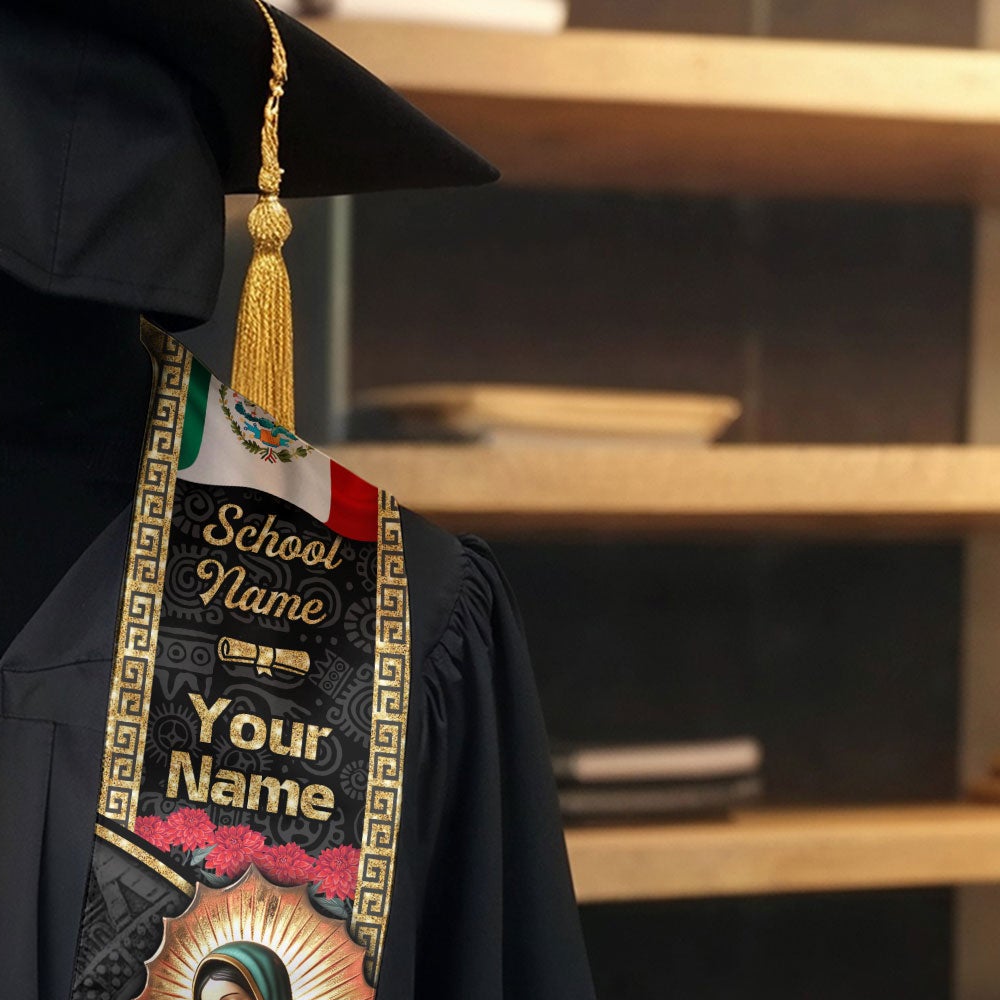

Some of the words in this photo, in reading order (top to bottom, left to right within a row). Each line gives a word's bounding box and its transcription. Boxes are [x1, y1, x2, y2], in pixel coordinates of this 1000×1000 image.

[202, 503, 343, 570] School
[196, 558, 327, 625] Name
[188, 693, 334, 760] Your
[166, 750, 335, 822] Name
